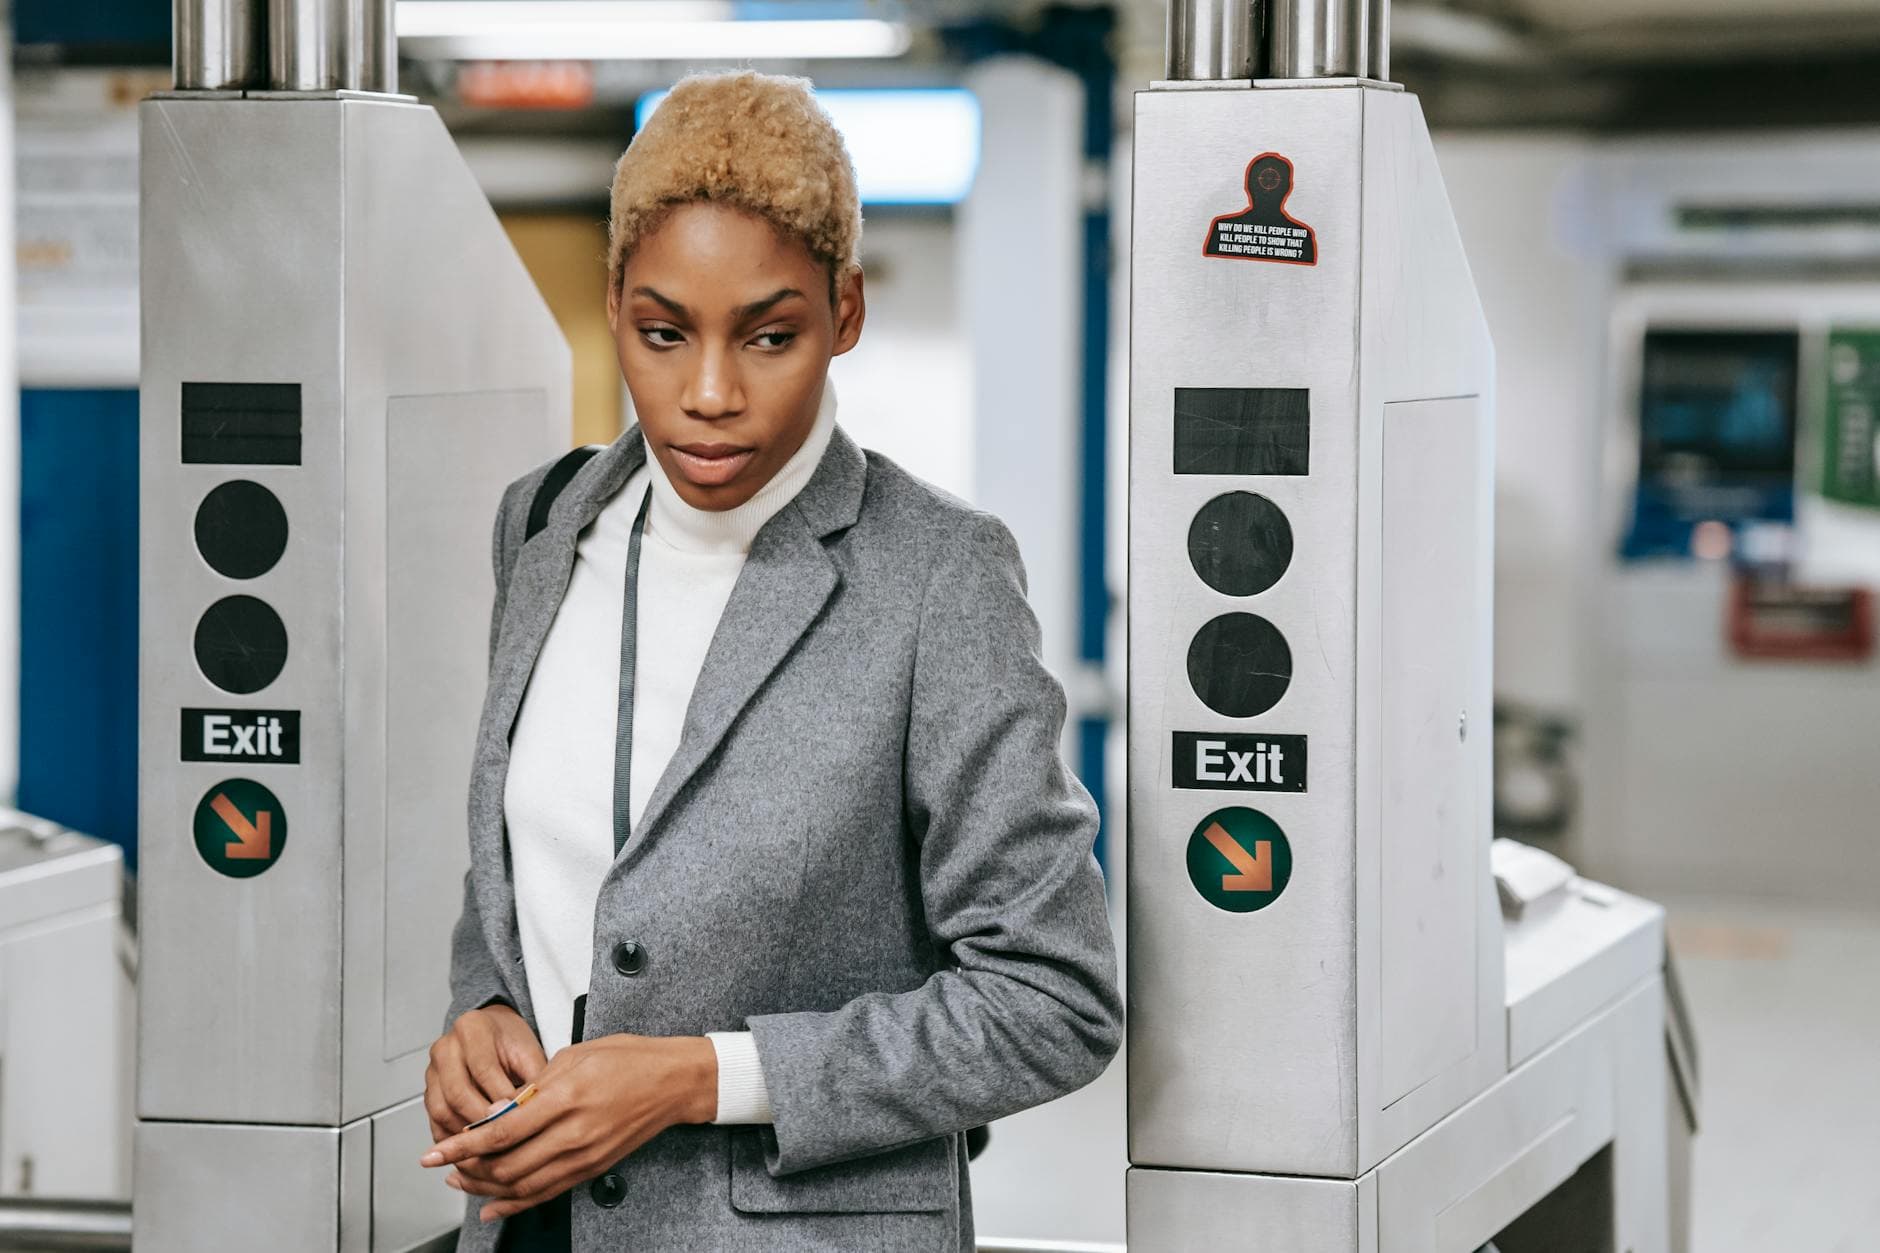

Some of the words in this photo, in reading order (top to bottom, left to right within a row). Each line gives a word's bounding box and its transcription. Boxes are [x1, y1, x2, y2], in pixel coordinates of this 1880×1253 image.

[1218, 223, 1233, 231] WHY
[1234, 224, 1242, 232] DO
[1244, 224, 1253, 232] WE
[1254, 225, 1267, 234] KILL
[1268, 226, 1292, 236] PEOPLE
[1293, 228, 1307, 238] WHO
[1220, 233, 1233, 241] KILL
[1234, 234, 1257, 244] PEOPLE
[1259, 236, 1266, 244] TO
[1267, 237, 1286, 247] SHOW
[1287, 239, 1303, 248] THAT
[1219, 243, 1242, 253] KILLING
[1243, 246, 1266, 255] PEOPLE
[1274, 248, 1297, 257] WRONG
[203, 715, 283, 756] Exit
[1196, 740, 1284, 784] Exit
